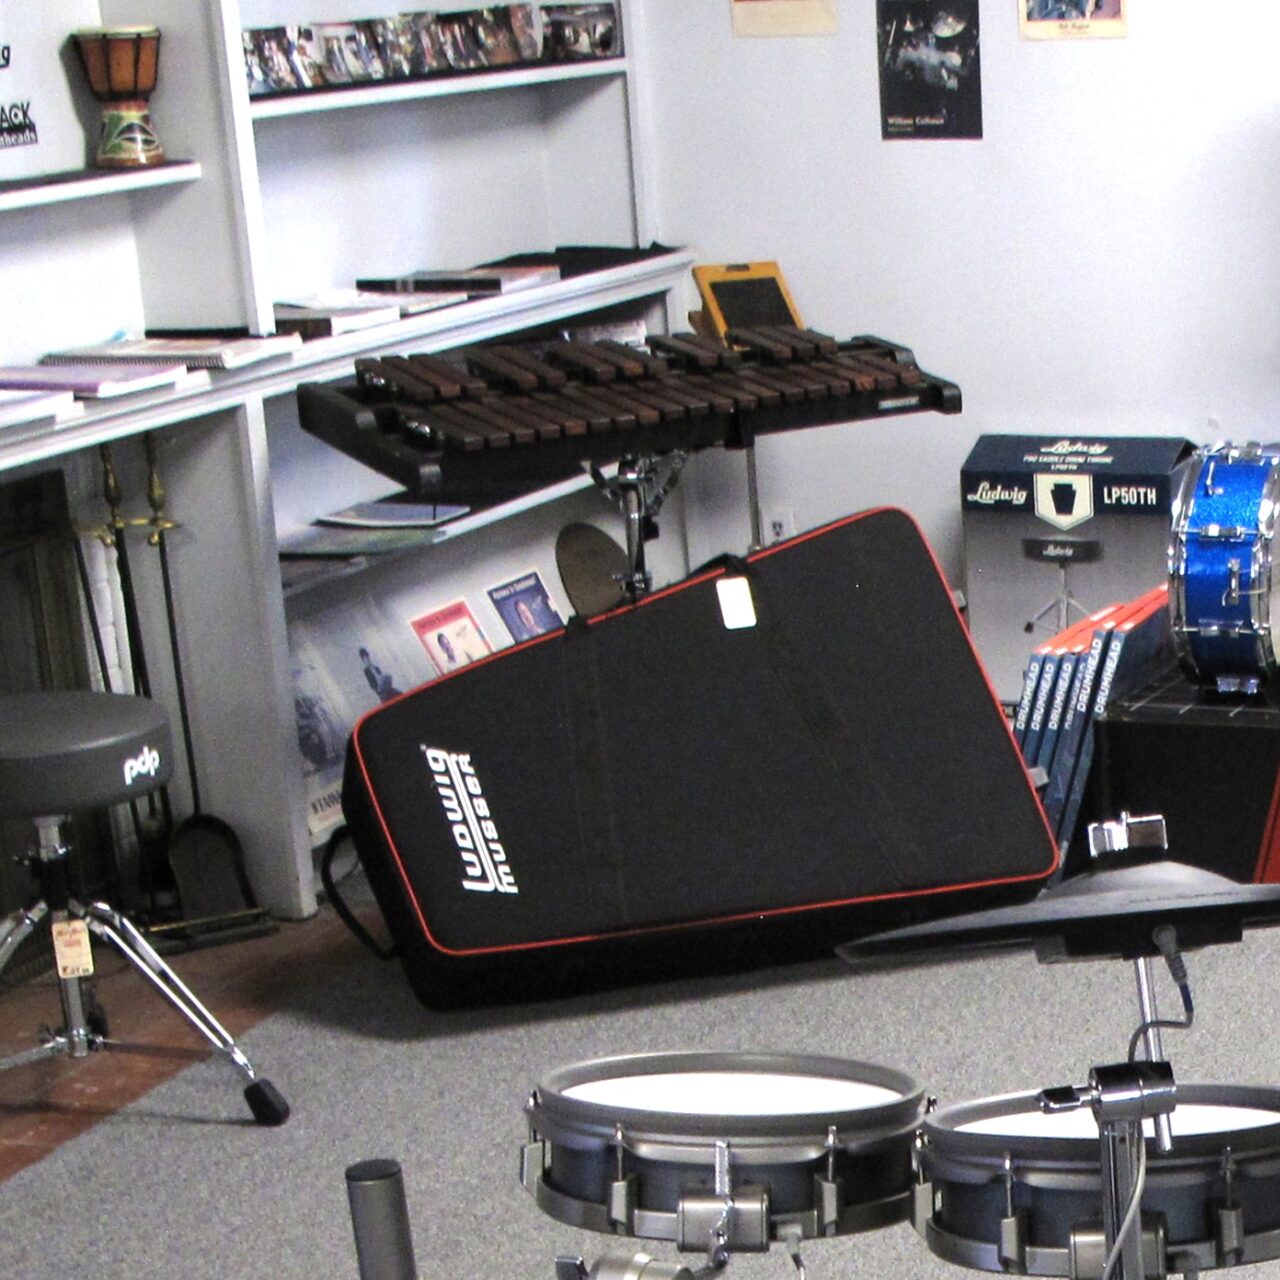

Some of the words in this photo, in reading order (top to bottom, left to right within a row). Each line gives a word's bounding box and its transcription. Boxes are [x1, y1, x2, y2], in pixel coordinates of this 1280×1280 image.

[1040, 440, 1108, 455] Ludwig
[967, 481, 1028, 505] Ludwig
[1103, 486, 1157, 506] LP50TH
[1016, 662, 1040, 731] DRUMHEAD
[1031, 663, 1055, 732] DRUMHEAD
[1048, 662, 1073, 731] DRUMHEAD
[1077, 637, 1102, 713] DRUMHEAD
[1094, 640, 1121, 714] DRUMHEAD
[124, 745, 160, 786] pdp
